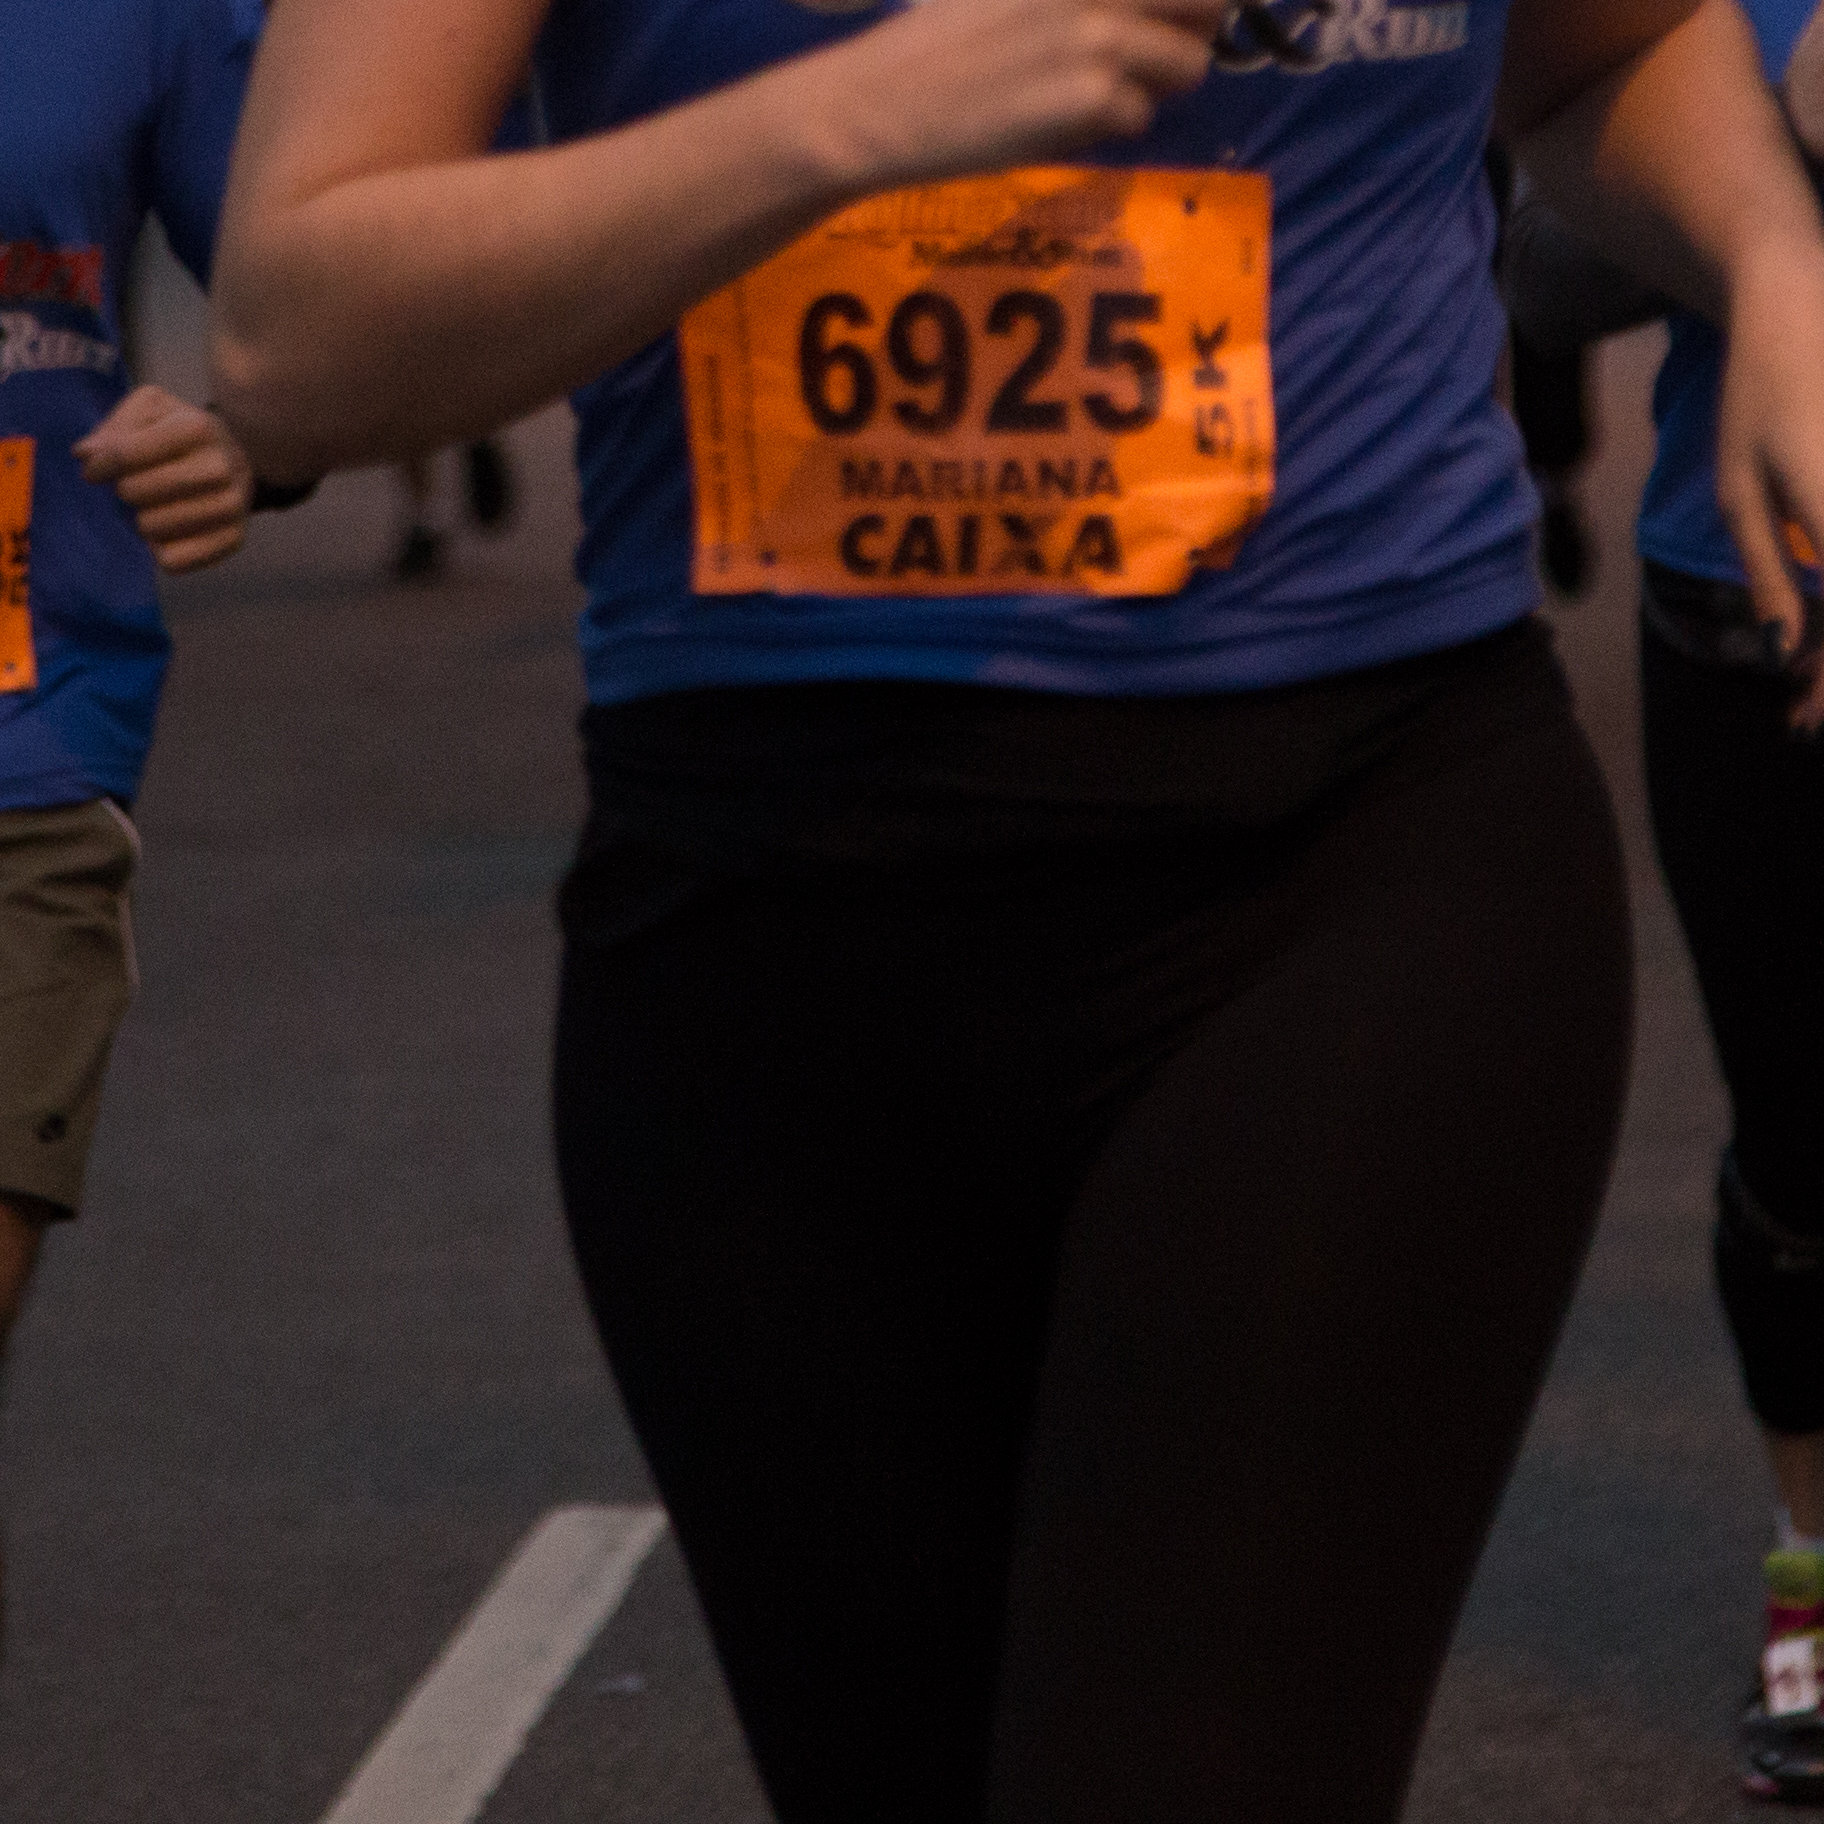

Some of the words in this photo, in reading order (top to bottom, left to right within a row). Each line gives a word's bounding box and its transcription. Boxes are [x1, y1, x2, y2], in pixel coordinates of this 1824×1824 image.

[798, 289, 1165, 438] 6925
[838, 458, 1122, 501] MARIANA
[838, 513, 1124, 577] CAIXA
